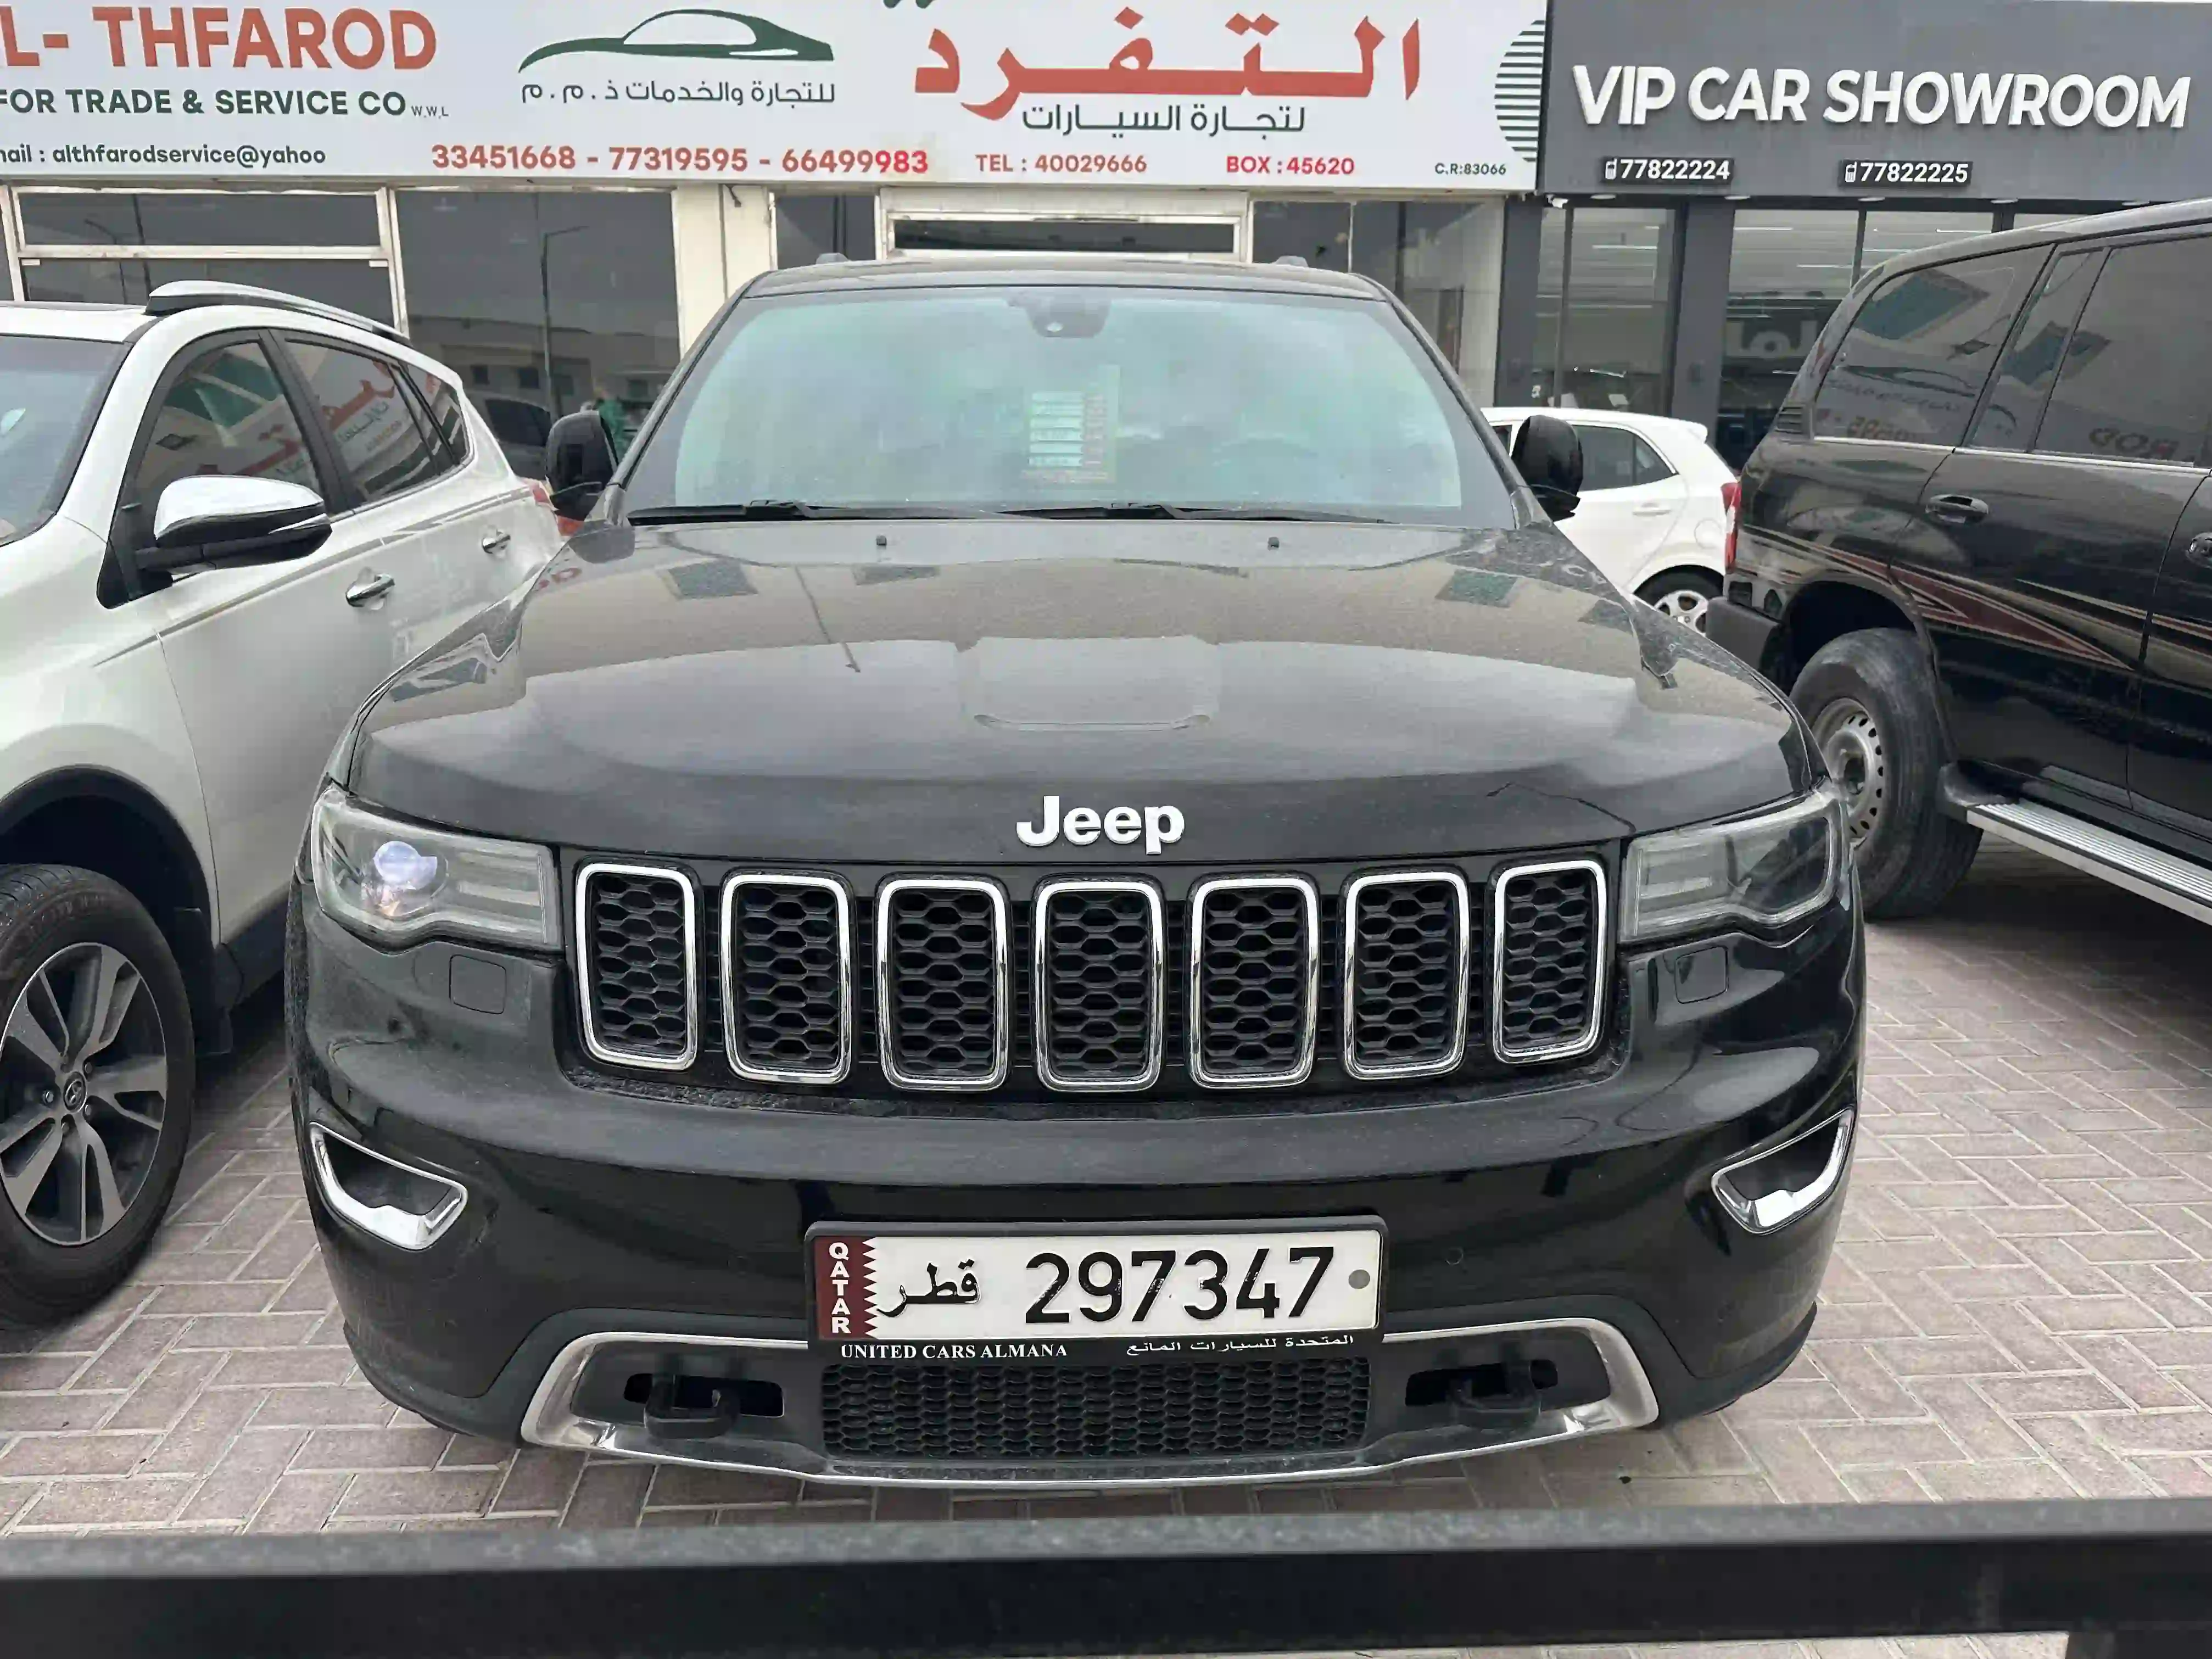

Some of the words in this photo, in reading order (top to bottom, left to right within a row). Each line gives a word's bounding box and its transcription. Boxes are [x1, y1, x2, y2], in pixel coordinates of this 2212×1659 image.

[92, 6, 437, 70] THFAROD
[914, 6, 1420, 121] التفرد
[65, 88, 172, 114] TRADE
[182, 90, 205, 114] &
[215, 90, 348, 116] SERVICE
[358, 91, 406, 116] CO
[625, 80, 744, 106] والخدمات
[751, 81, 835, 109] للتجارة
[1573, 65, 1676, 125] VIP
[1688, 66, 1811, 122] CAR
[1823, 69, 2192, 129] SHOWROOM
[1022, 104, 1181, 139] السيارات
[1191, 104, 1305, 141] لتجارة
[52, 143, 326, 169] althfarodservice@yahoo
[432, 144, 576, 170] 33451668
[608, 147, 748, 172] 77319595
[782, 148, 929, 174] 66499983
[975, 154, 1014, 172] TEL
[1035, 154, 1147, 174] 40029666
[1226, 155, 1271, 174] BOX
[1620, 159, 1731, 181] 77822224
[1859, 162, 1969, 184] 77822225
[1016, 795, 1185, 855] Jeep
[828, 1242, 851, 1334] QATAR
[876, 1259, 980, 1317] قطر
[1025, 1246, 1334, 1324] 297347
[841, 1344, 917, 1359] UNITED
[922, 1344, 976, 1359] CARS
[981, 1343, 1068, 1358] ALMANA
[1126, 1342, 1181, 1356] المانع
[1191, 1337, 1277, 1354] للسيارات
[1285, 1335, 1354, 1348] المتحدة
